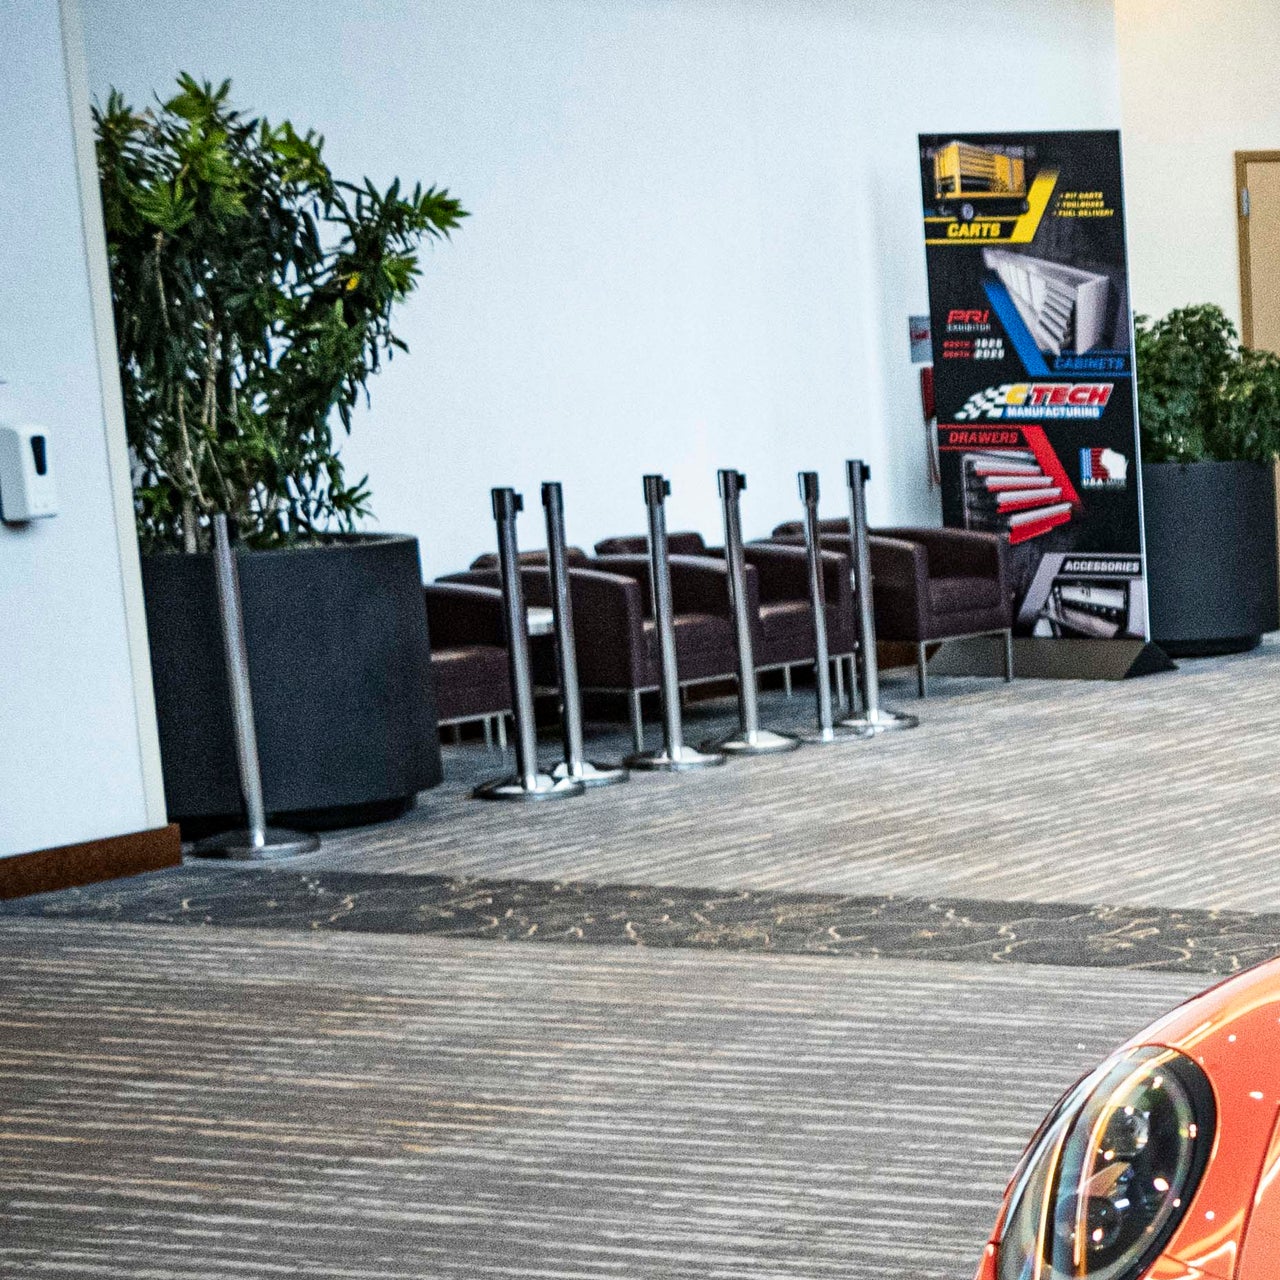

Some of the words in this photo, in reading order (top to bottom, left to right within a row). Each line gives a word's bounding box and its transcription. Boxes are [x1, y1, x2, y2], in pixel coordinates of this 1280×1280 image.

[946, 222, 1001, 237] CARTS
[947, 309, 989, 324] PRI
[1053, 357, 1125, 369] CABINETS
[1007, 406, 1100, 418] MANUFACTURING
[949, 431, 1018, 444] DRAWERS
[1064, 560, 1140, 572] ACCESSORIES
